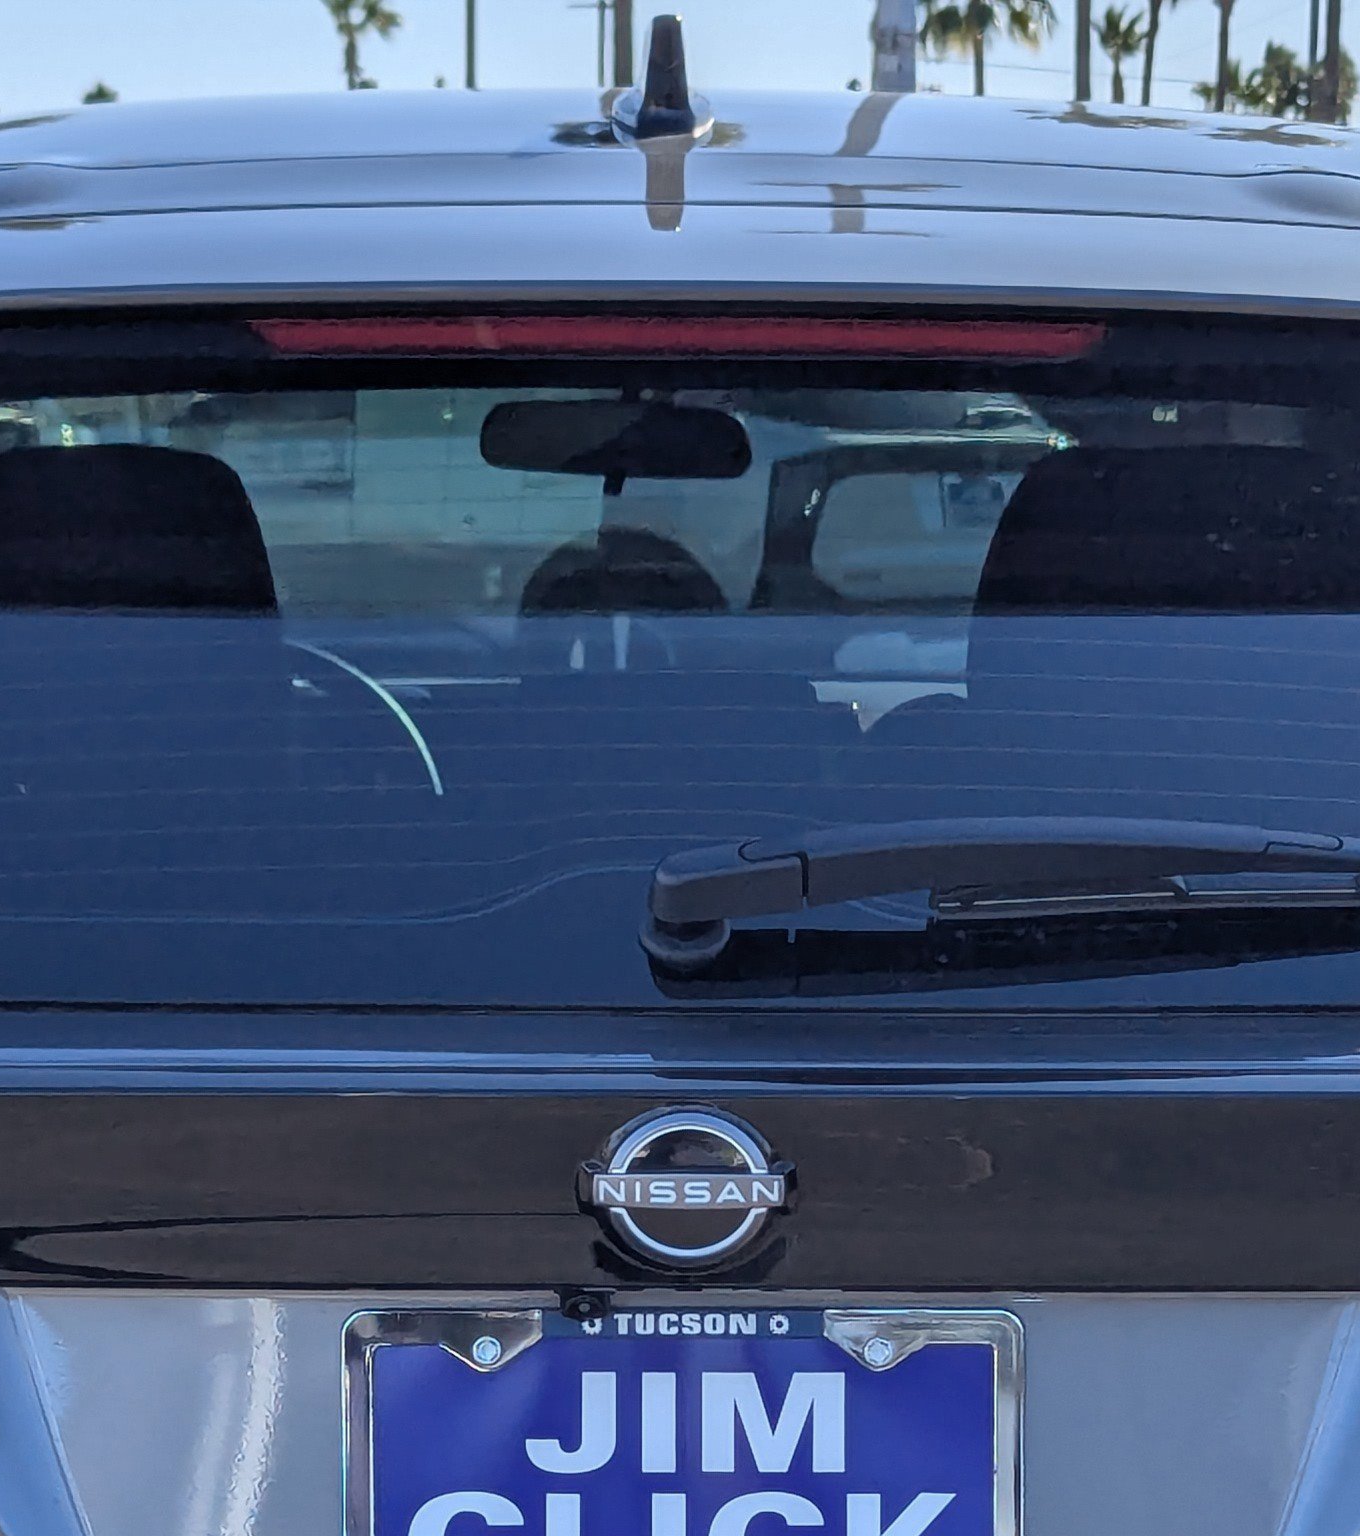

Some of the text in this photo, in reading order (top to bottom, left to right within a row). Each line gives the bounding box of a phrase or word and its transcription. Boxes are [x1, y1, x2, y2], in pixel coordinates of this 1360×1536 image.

[597, 1179, 780, 1204] NISSAN
[613, 1312, 757, 1335] TUCSON
[525, 1371, 846, 1474] JIM
